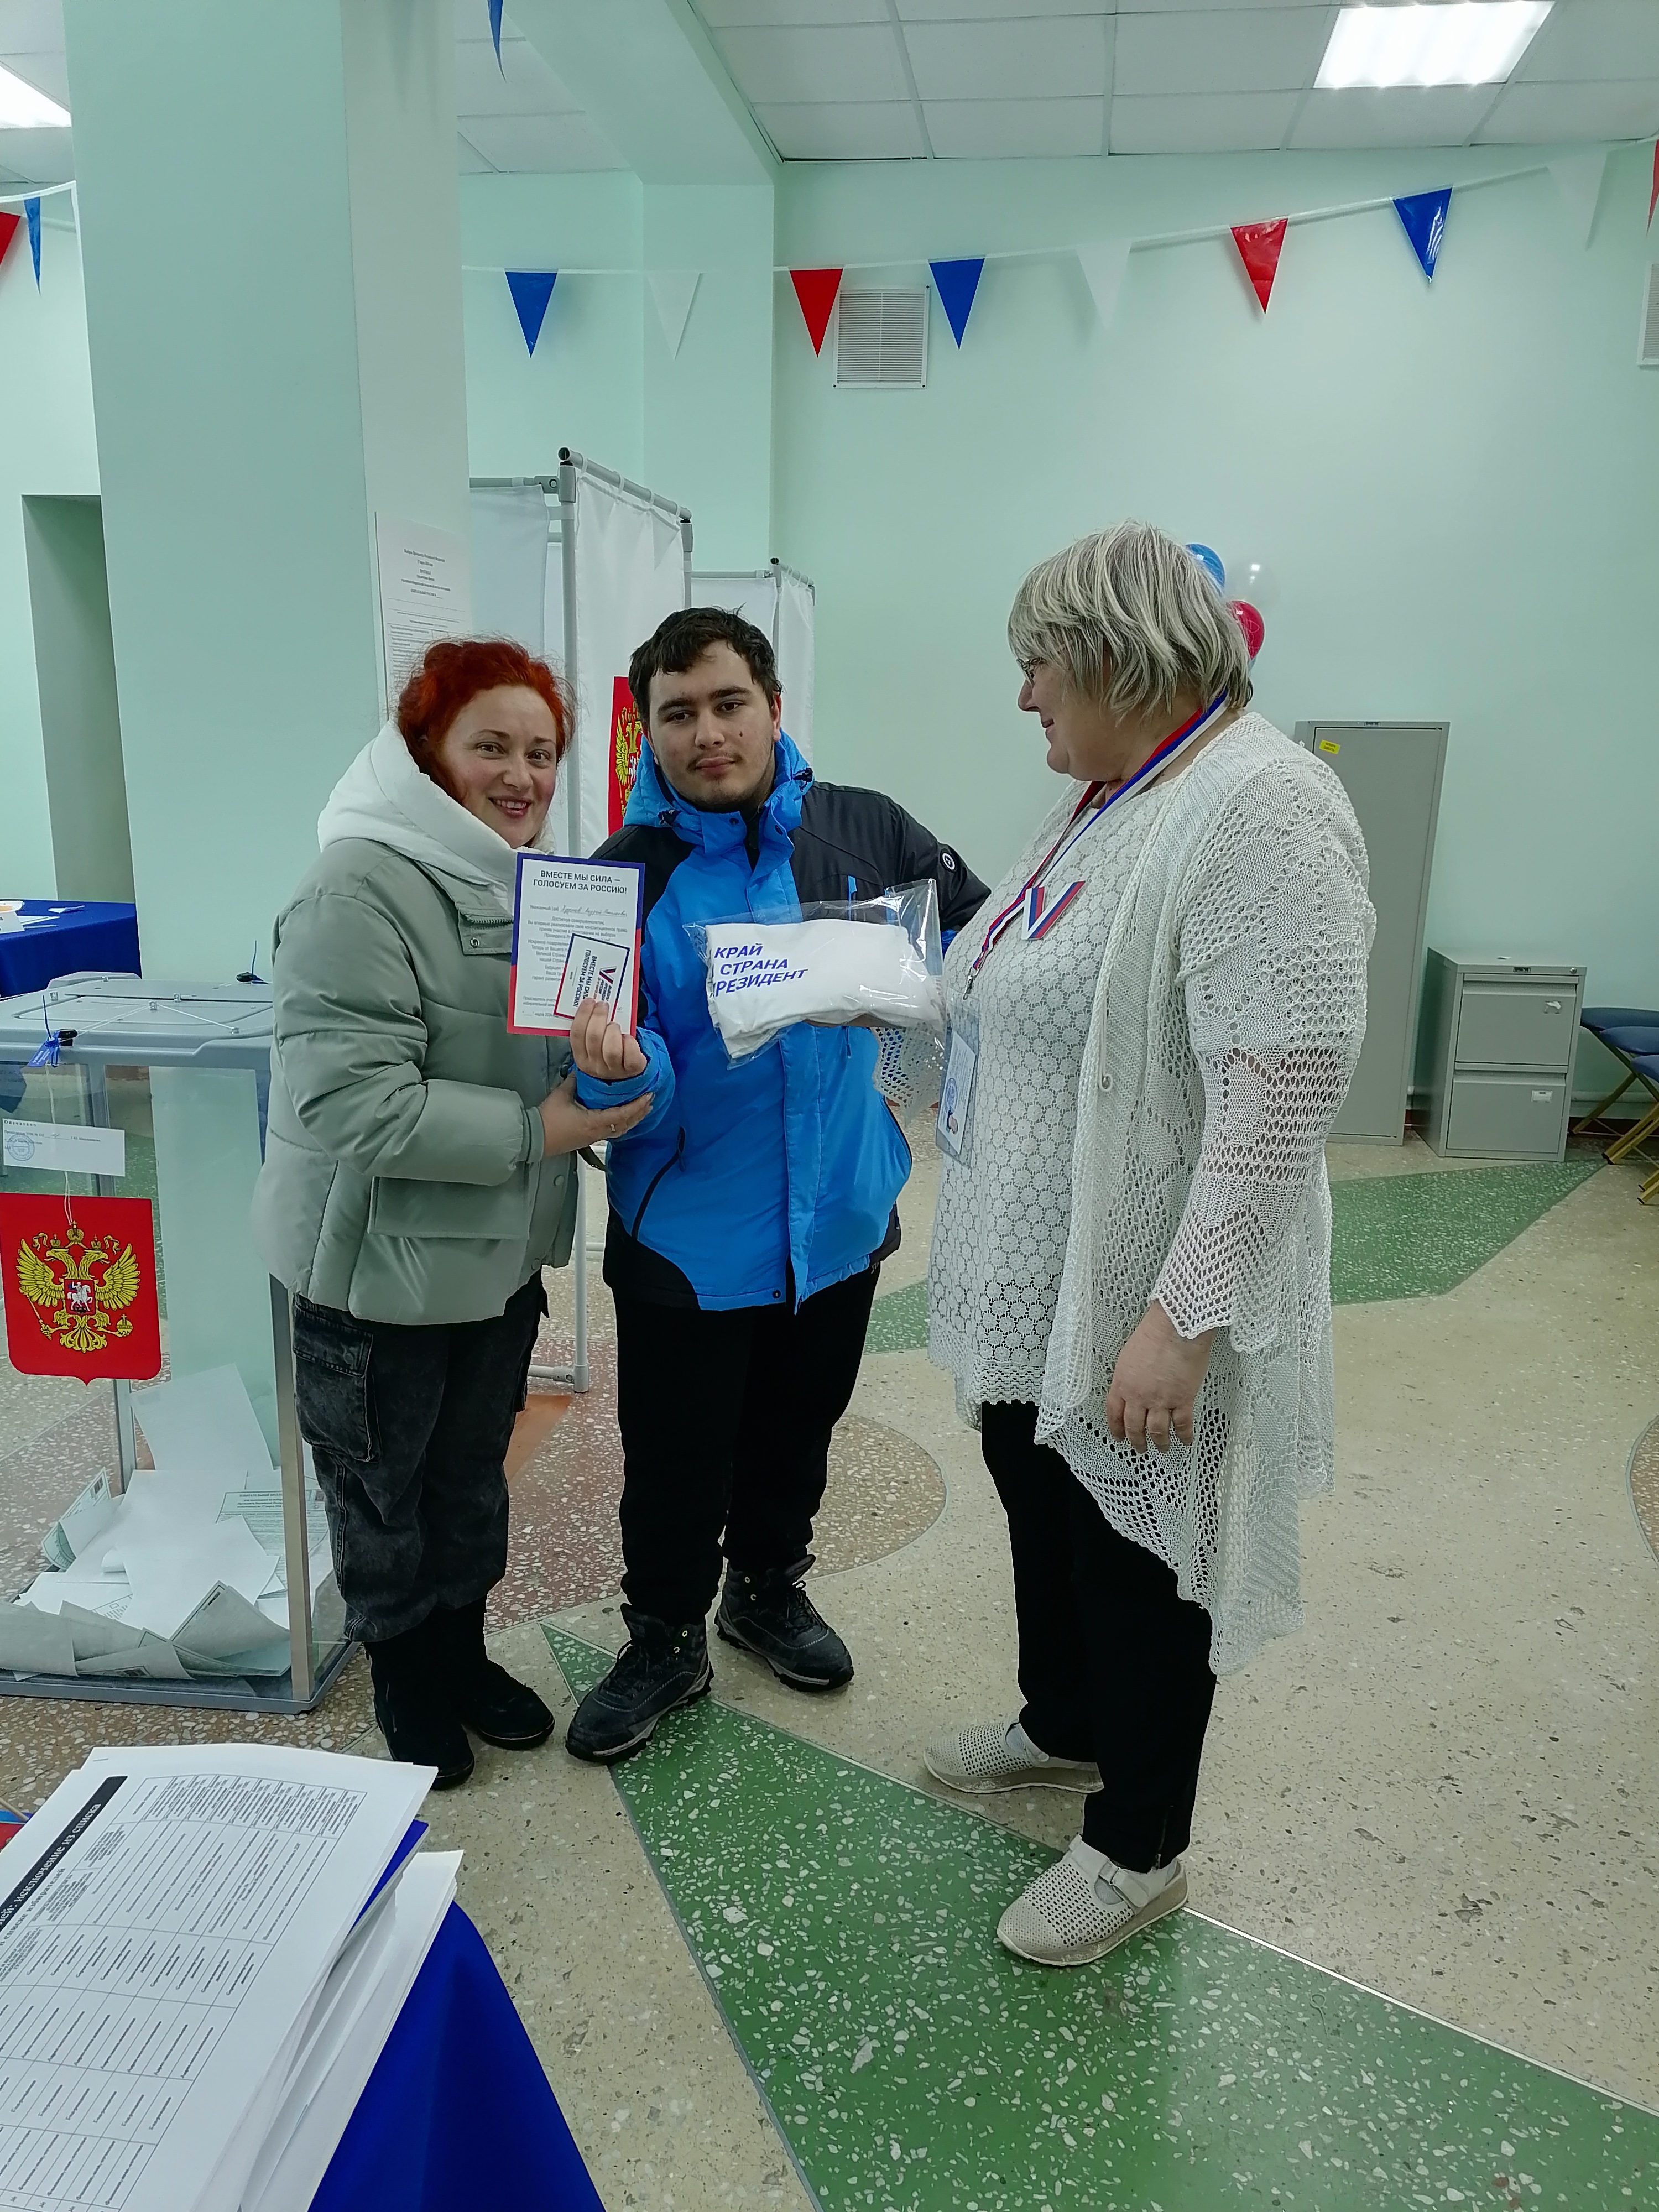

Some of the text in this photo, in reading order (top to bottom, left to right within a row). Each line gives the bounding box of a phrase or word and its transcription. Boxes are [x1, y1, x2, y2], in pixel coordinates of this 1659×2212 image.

[540, 870, 572, 880] ВМЕСТЕ
[590, 875, 613, 883] СИЛА
[533, 879, 576, 890] ГОЛОСУЕМ
[591, 884, 627, 894] РОССИЮ!
[714, 943, 763, 959] КРАЙ
[581, 949, 591, 976] ГОЛОСУЕМ
[588, 956, 597, 975] ВМЕСТЕ
[720, 959, 788, 975] СТРАНА
[586, 976, 593, 986] МЫ
[573, 983, 583, 1008] РОССИЮ!
[14, 1846, 65, 1902] исключение
[62, 1834, 75, 1845] из
[72, 1803, 101, 1834] списка
[26, 1867, 66, 1912] избирателей
